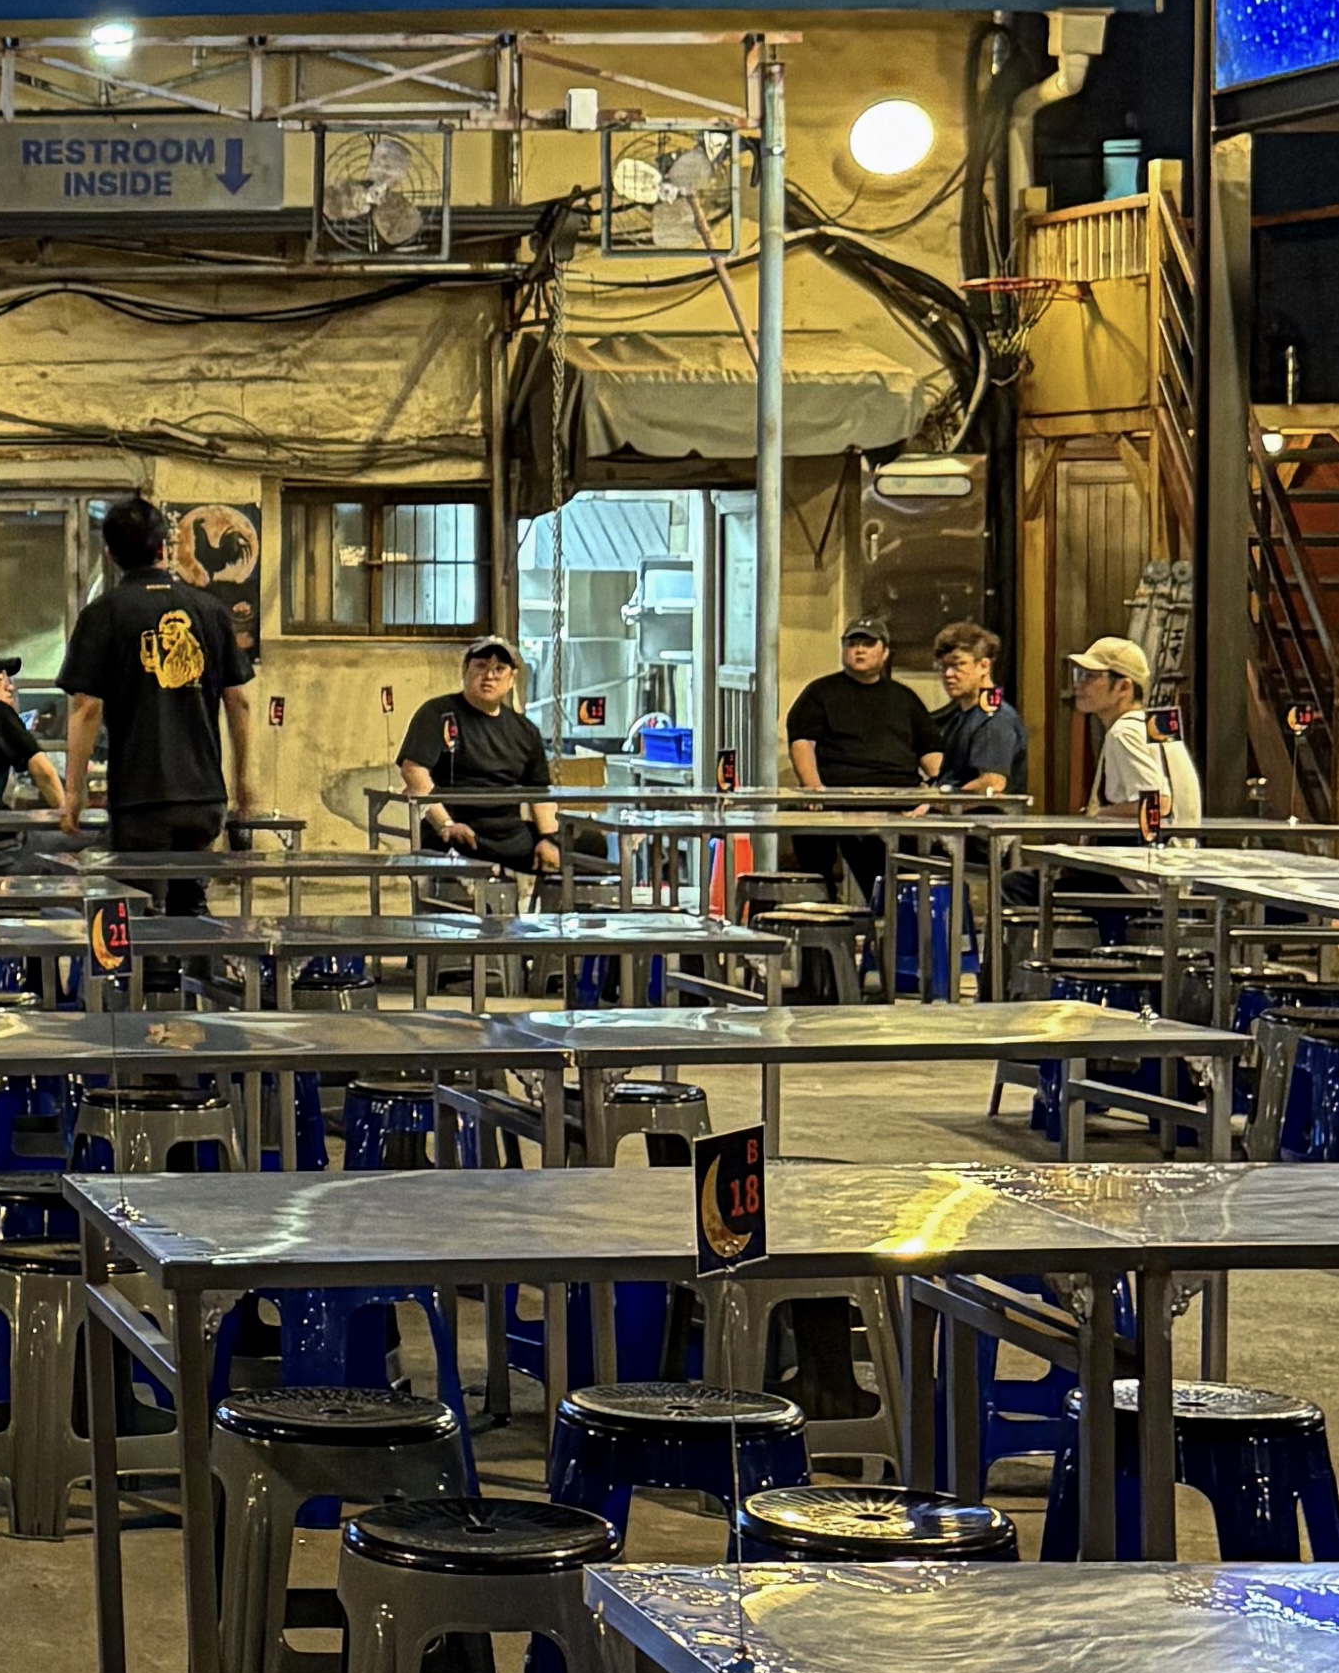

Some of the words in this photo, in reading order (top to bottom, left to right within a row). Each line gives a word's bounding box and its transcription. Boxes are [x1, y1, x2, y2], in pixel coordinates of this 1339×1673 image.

[22, 137, 215, 165] RESTROOM
[63, 171, 172, 197] INSIDE
[109, 923, 128, 947] 21
[746, 1139, 759, 1165] B
[730, 1174, 760, 1217] 18
